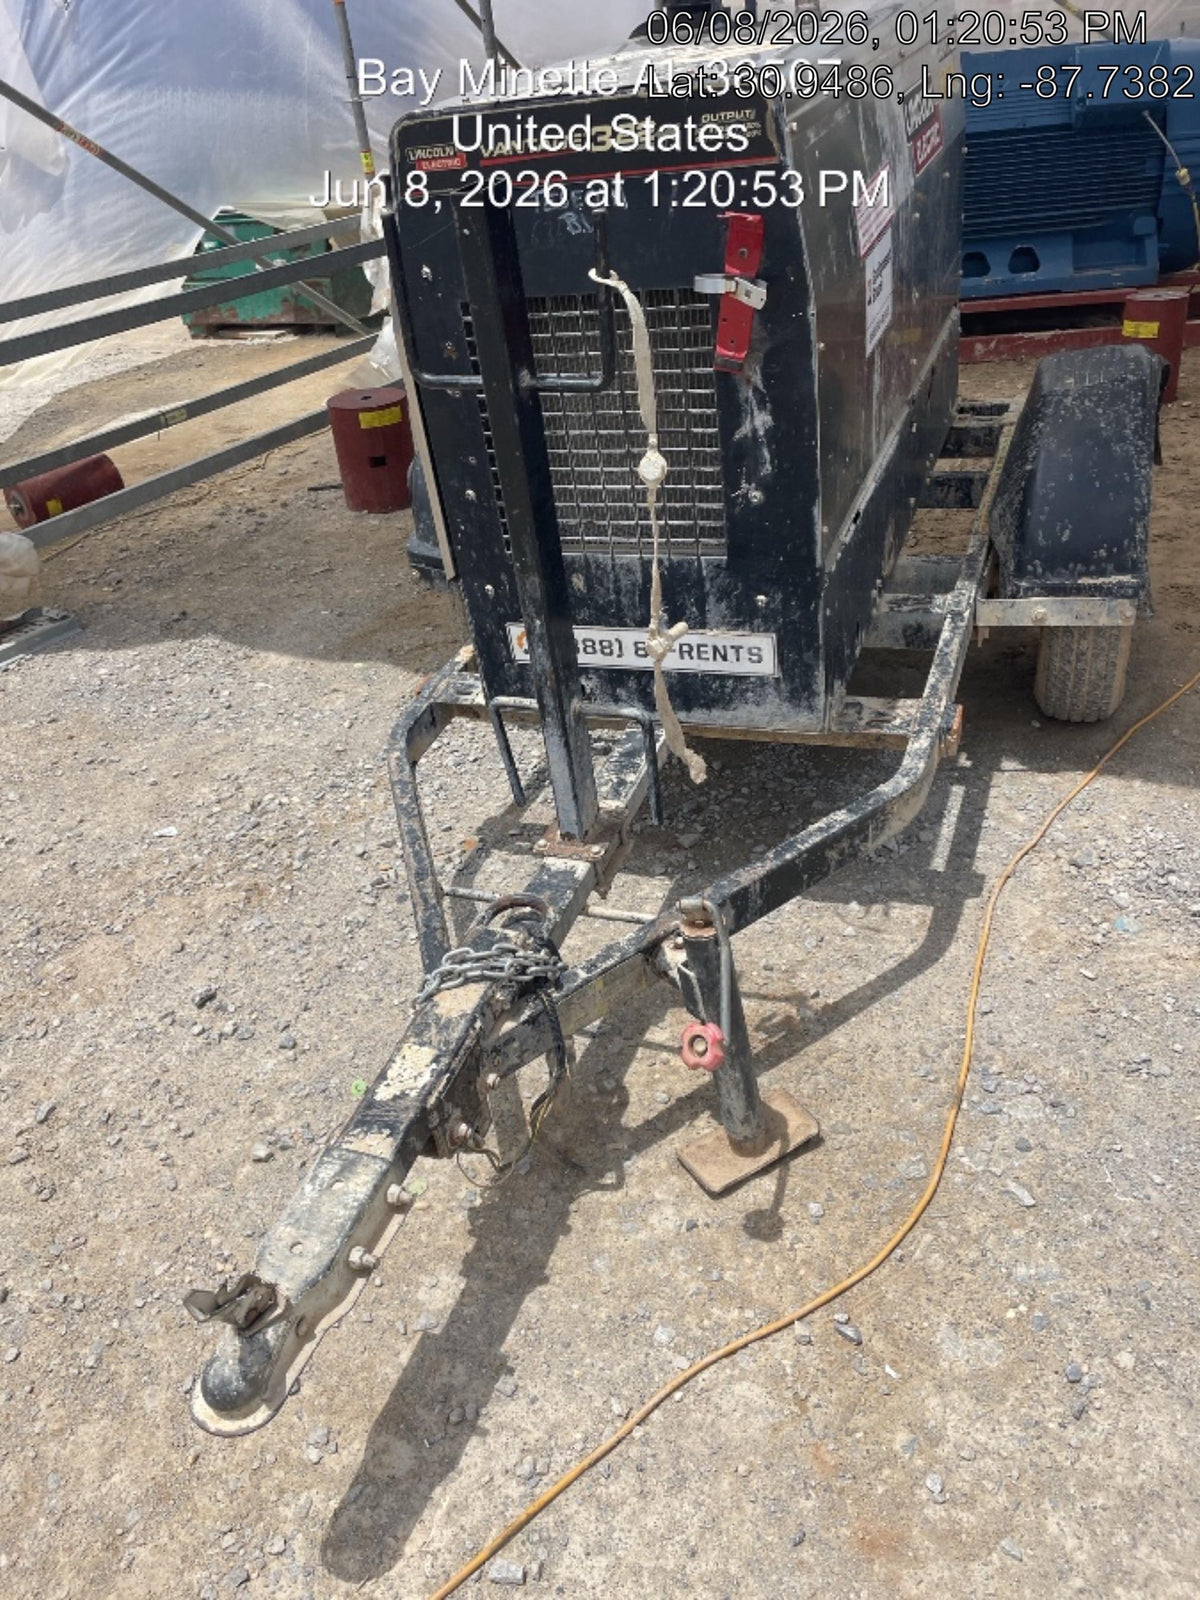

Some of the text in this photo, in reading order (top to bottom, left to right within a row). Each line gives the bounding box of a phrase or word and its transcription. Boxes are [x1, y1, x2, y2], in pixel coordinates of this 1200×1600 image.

[701, 109, 753, 124] OUTPUT
[408, 146, 455, 162] LINCOLN
[575, 637, 764, 664] 88) 8-RENTS
